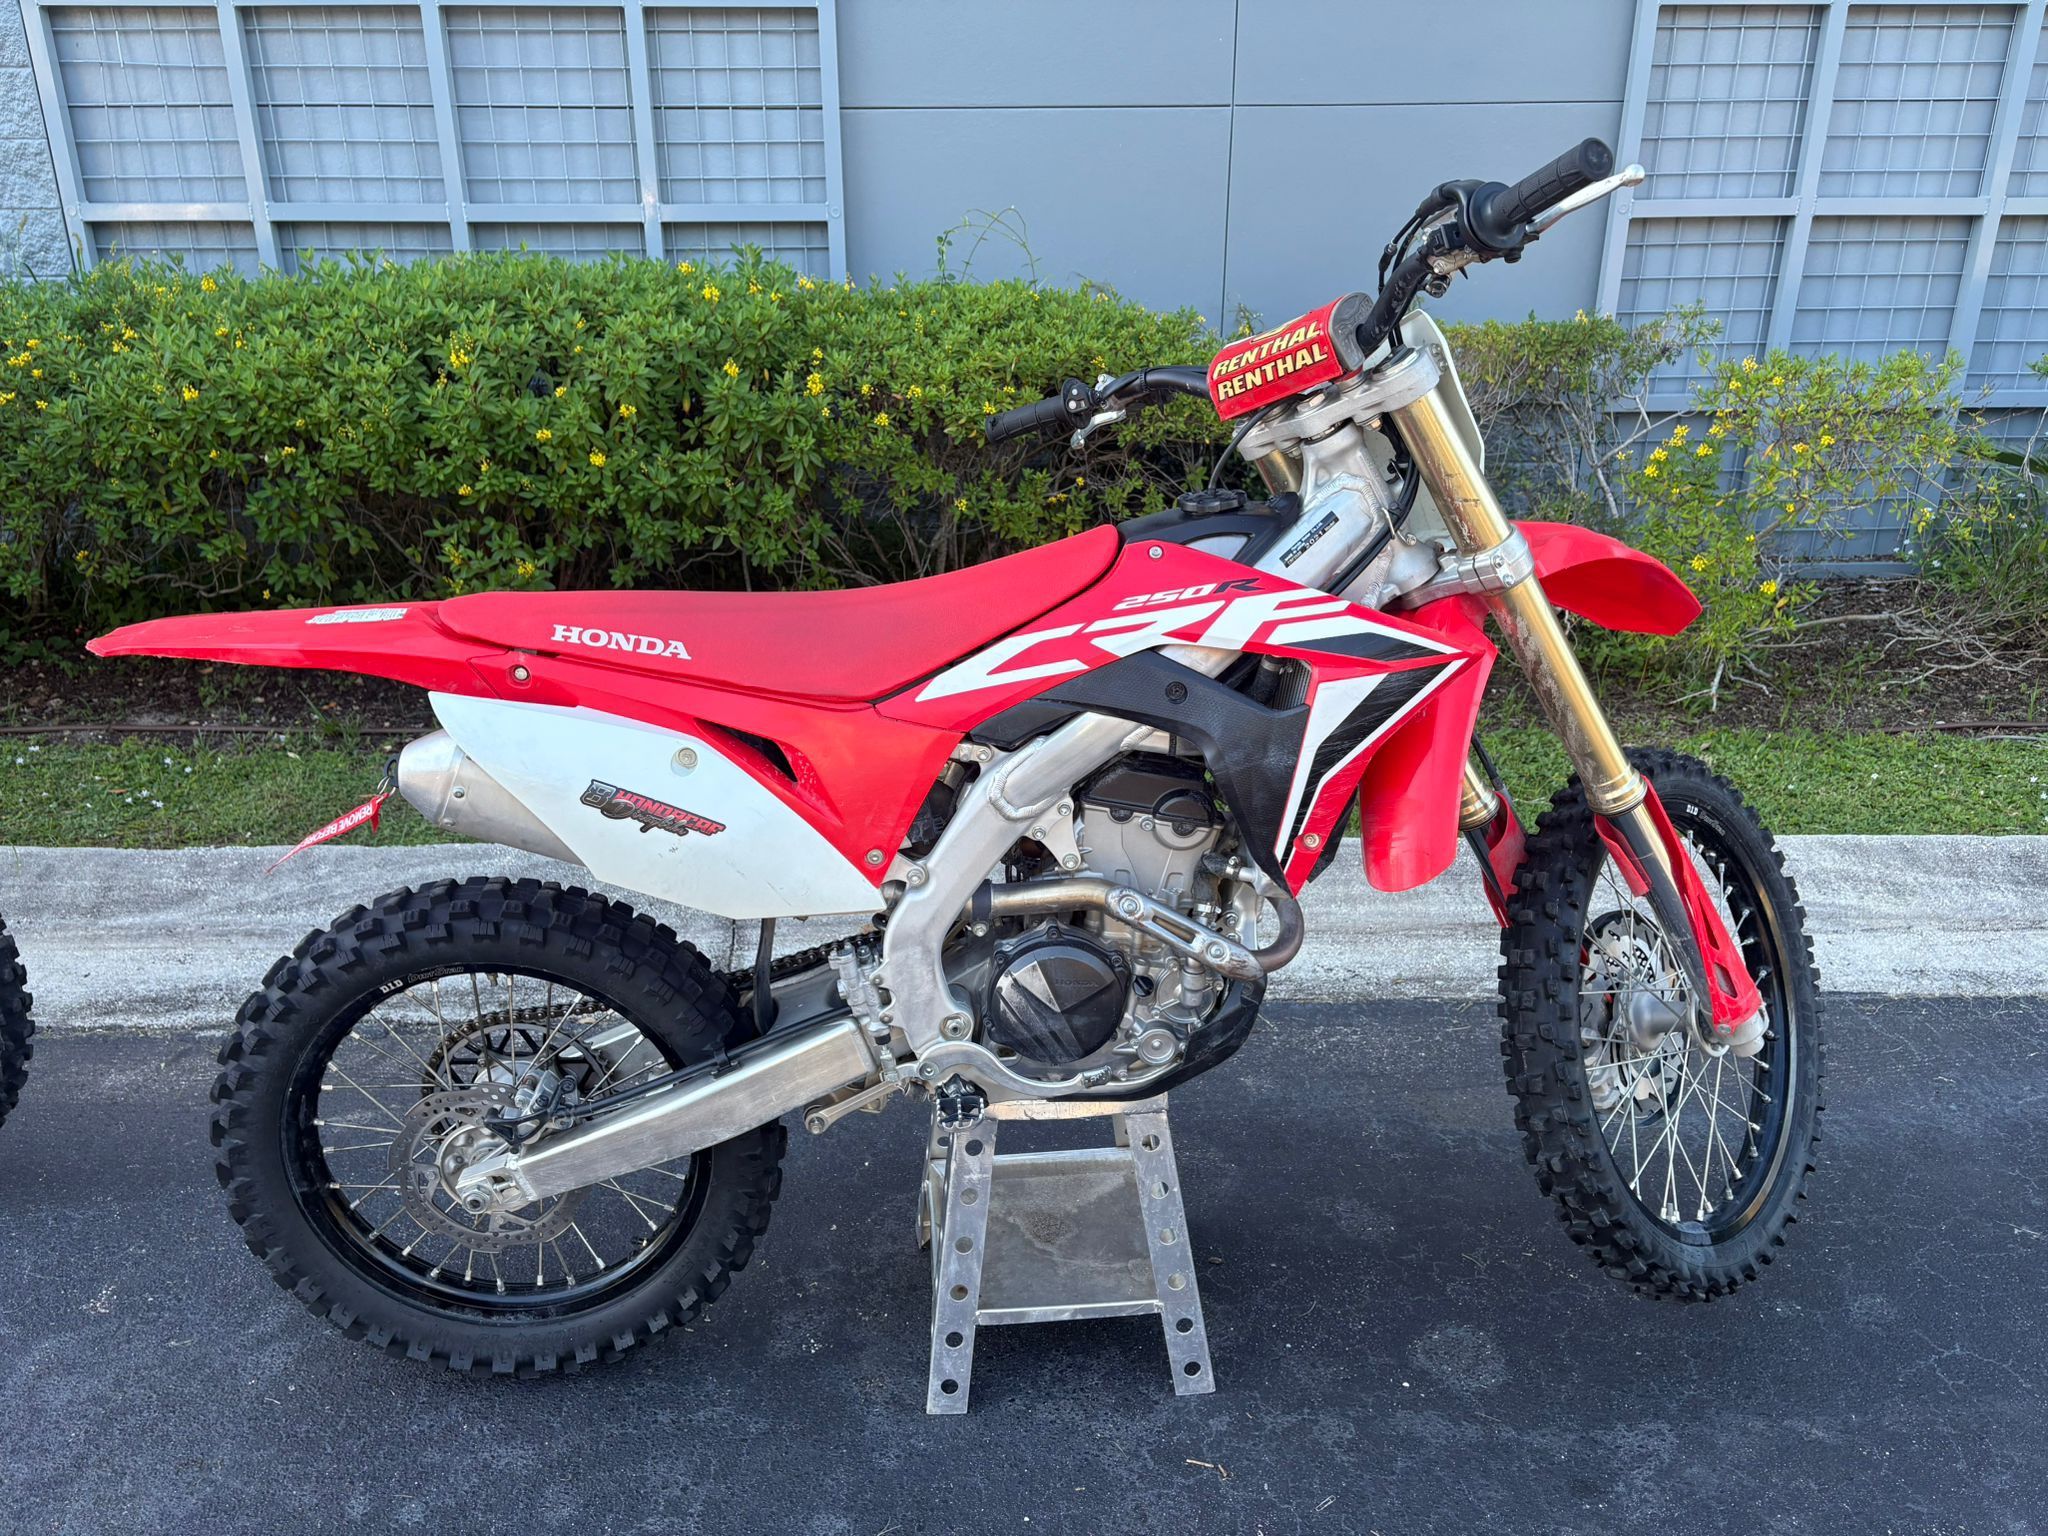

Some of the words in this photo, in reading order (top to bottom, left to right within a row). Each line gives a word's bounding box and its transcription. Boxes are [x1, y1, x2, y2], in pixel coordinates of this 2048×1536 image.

[1213, 320, 1321, 381] RENTHAL
[1217, 343, 1329, 402] RENTHAL
[1112, 578, 1265, 611] 250R
[551, 624, 692, 660] HONDA
[338, 803, 373, 832] REMOVE
[380, 979, 404, 994] DID
[1055, 978, 1100, 988] HONDA
